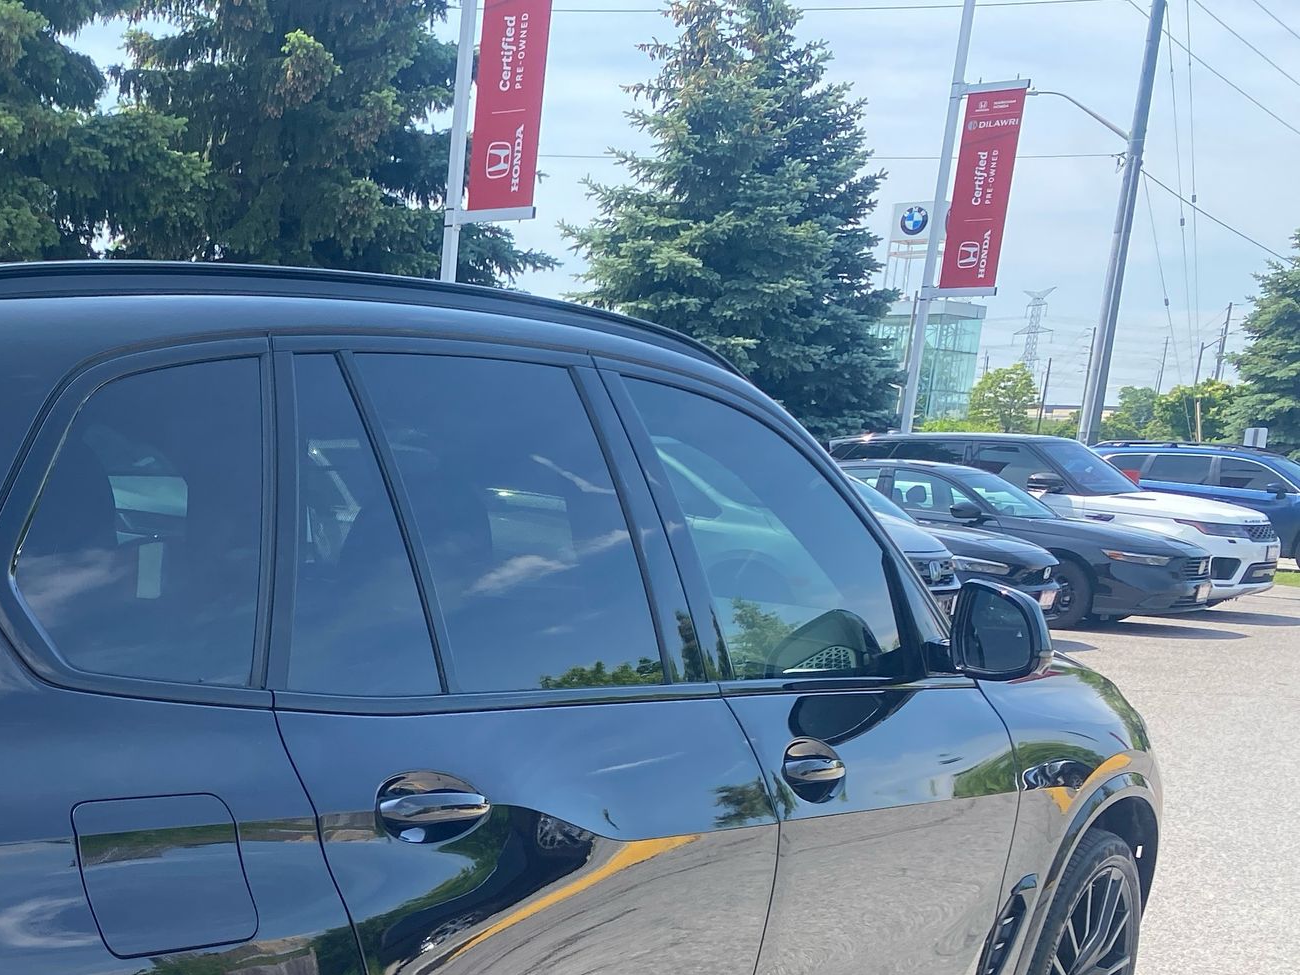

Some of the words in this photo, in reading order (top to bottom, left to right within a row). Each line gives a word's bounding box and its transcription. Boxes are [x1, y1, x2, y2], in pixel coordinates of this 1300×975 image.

[499, 16, 516, 91] Certified
[515, 12, 529, 90] PRE-OWNED
[979, 118, 1019, 128] DILAWRI
[511, 124, 524, 192] HONDA
[972, 151, 988, 205] Certified
[984, 149, 999, 204] PRE-OWNED
[977, 229, 991, 278] HONDA
